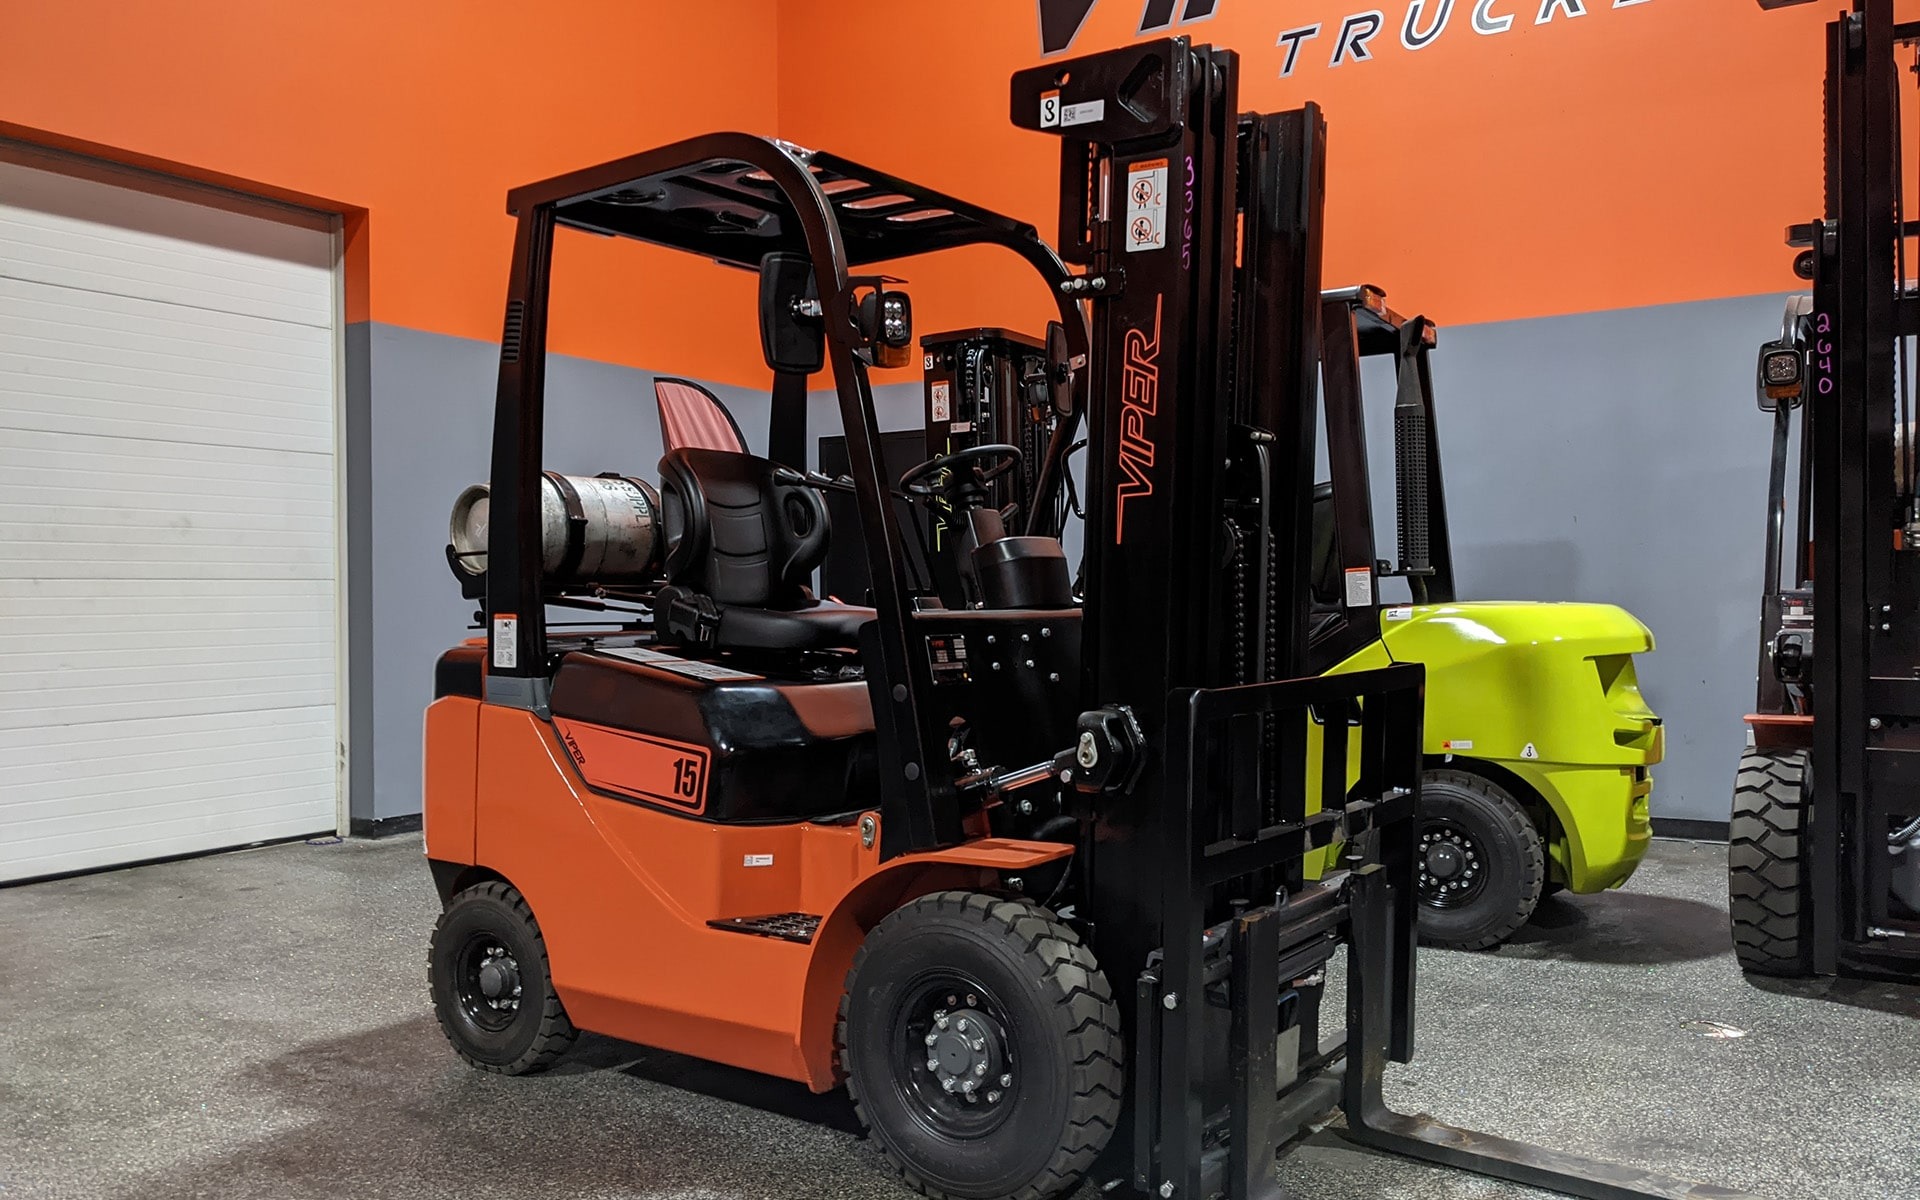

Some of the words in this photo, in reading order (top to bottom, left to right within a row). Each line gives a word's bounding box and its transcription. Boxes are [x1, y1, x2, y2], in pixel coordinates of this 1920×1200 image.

[1275, 0, 1655, 80] TRUC
[1182, 156, 1195, 270] 3365
[1816, 313, 1833, 394] 2640
[1116, 292, 1163, 545] VIPER
[564, 724, 586, 765] VIPER
[673, 757, 698, 798] 15
